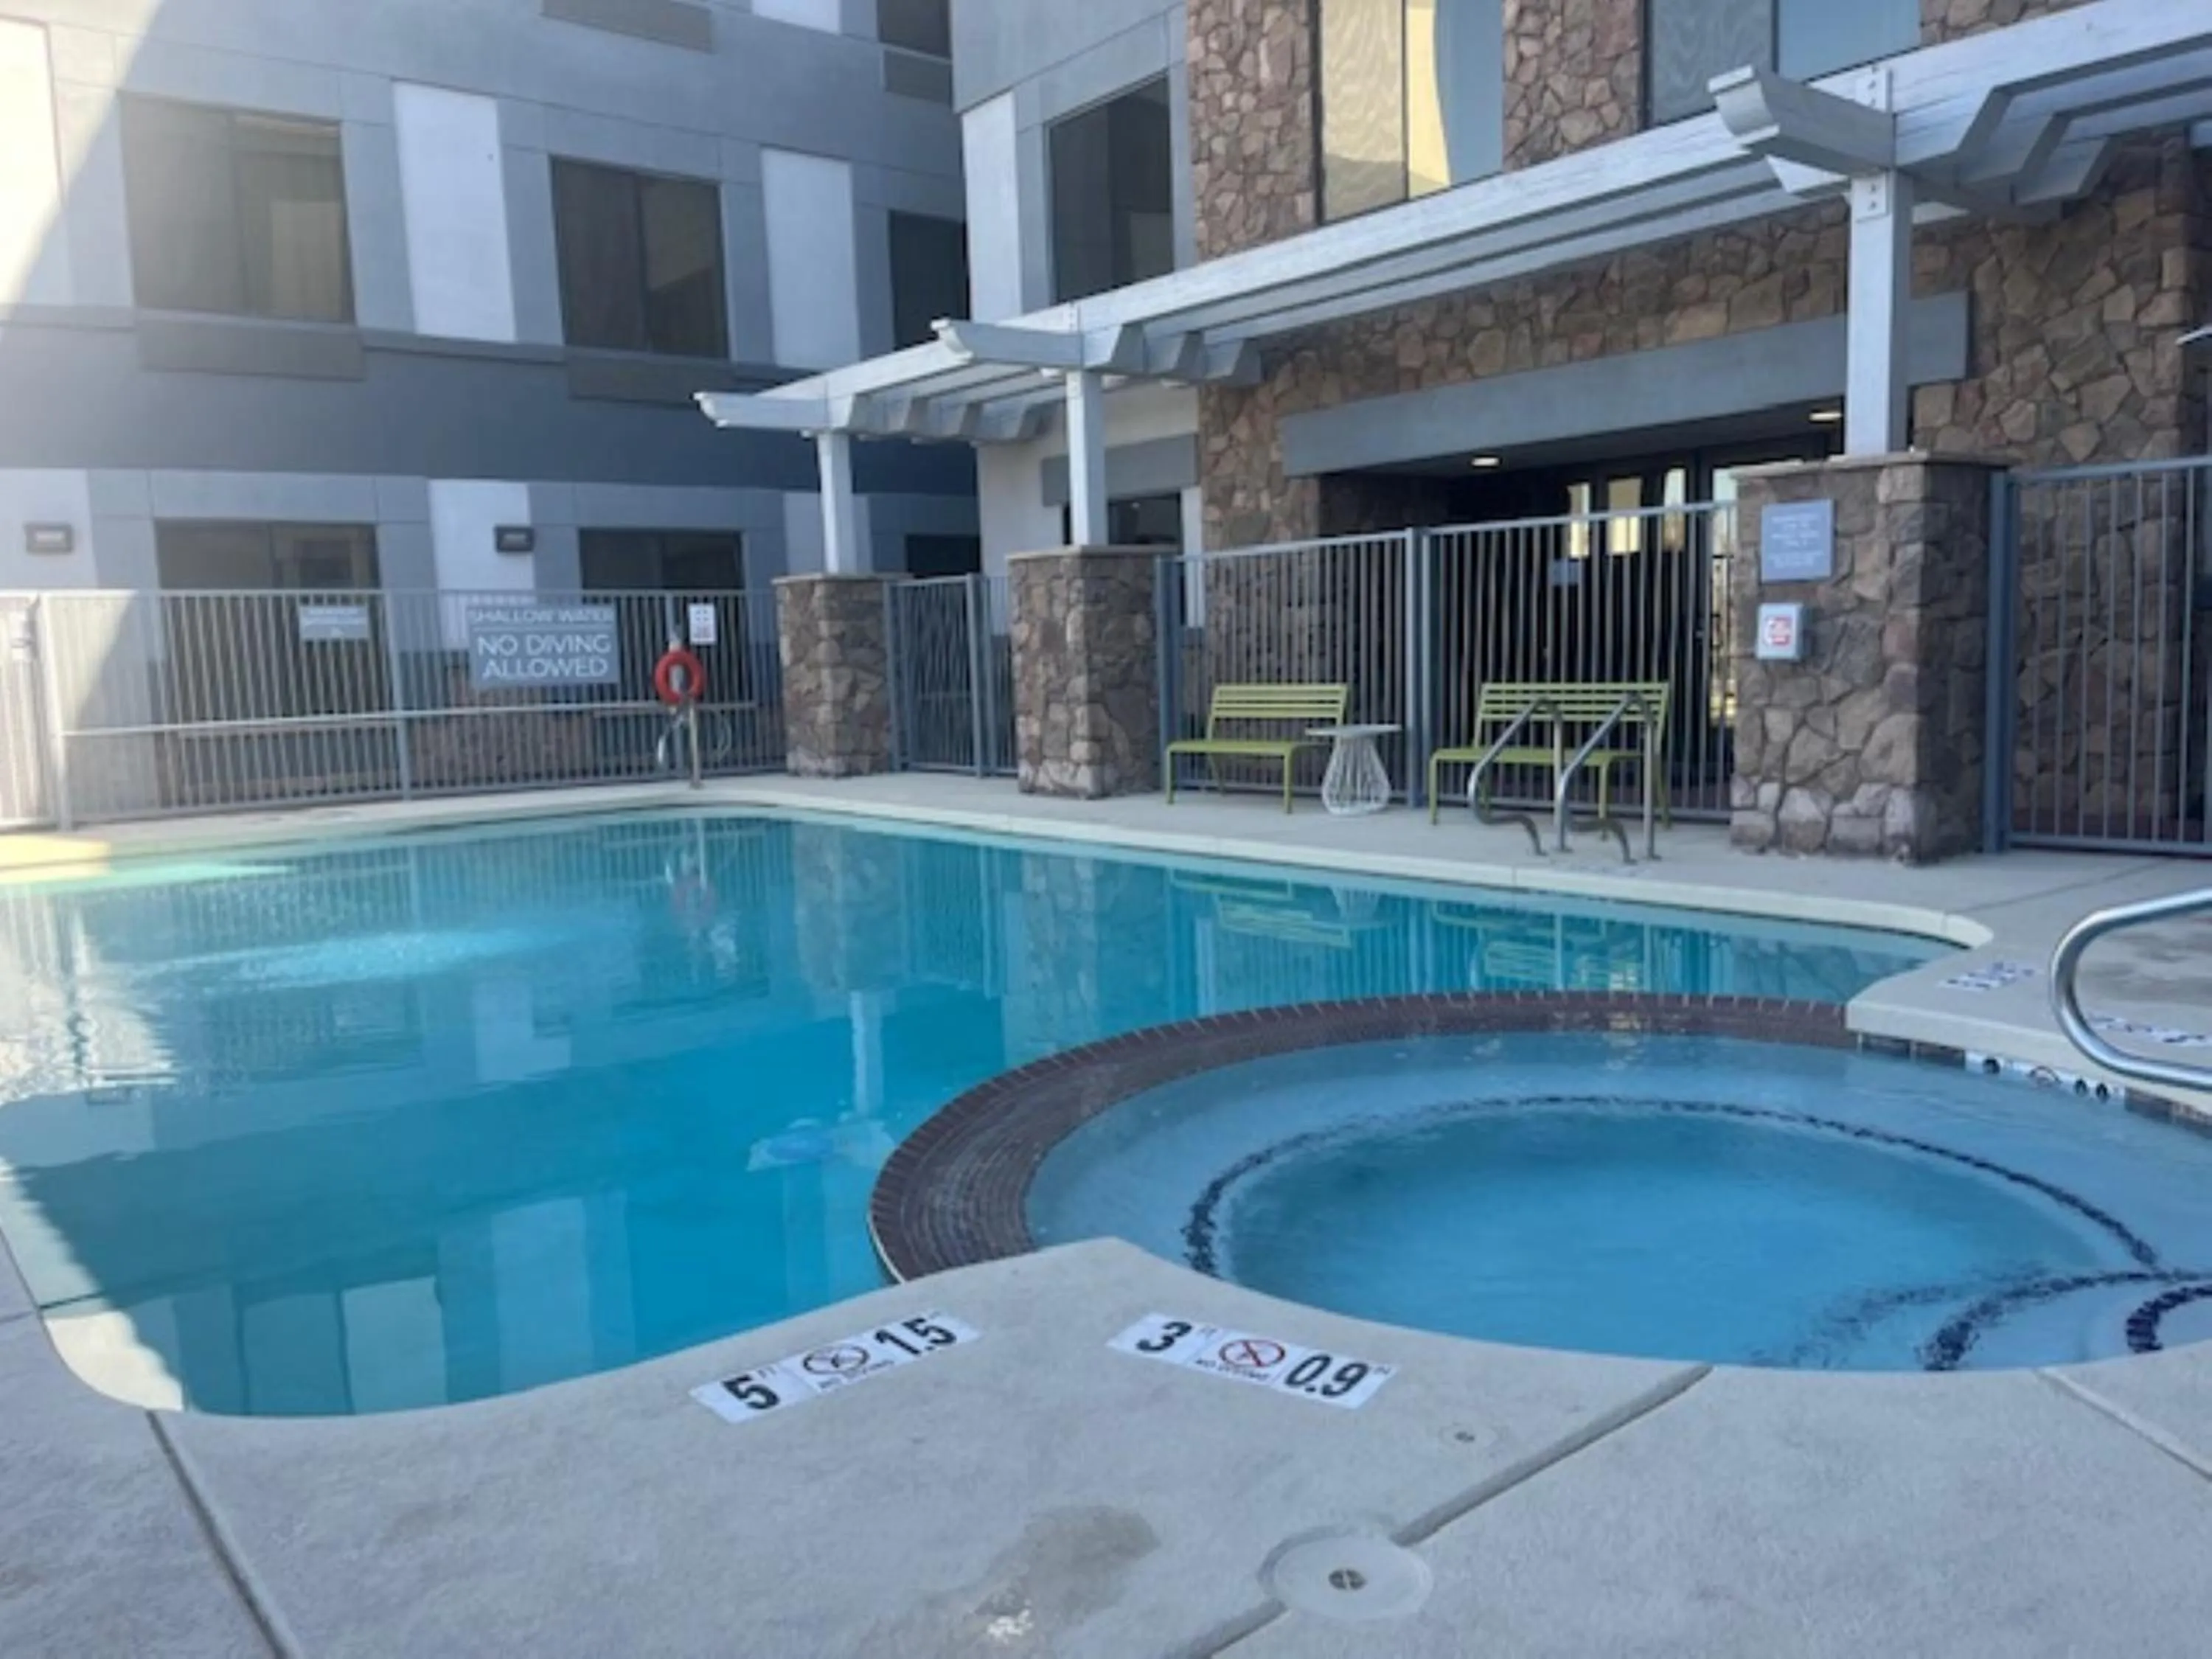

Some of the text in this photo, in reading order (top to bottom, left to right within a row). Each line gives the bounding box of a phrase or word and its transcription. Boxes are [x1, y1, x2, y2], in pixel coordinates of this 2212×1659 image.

[479, 634, 611, 655] NO DIVING
[482, 658, 608, 680] ALLOWED
[722, 1374, 780, 1410] 5
[874, 1317, 957, 1357] 1.5
[1136, 1321, 1192, 1352] 3
[1284, 1354, 1370, 1397] 0.9
